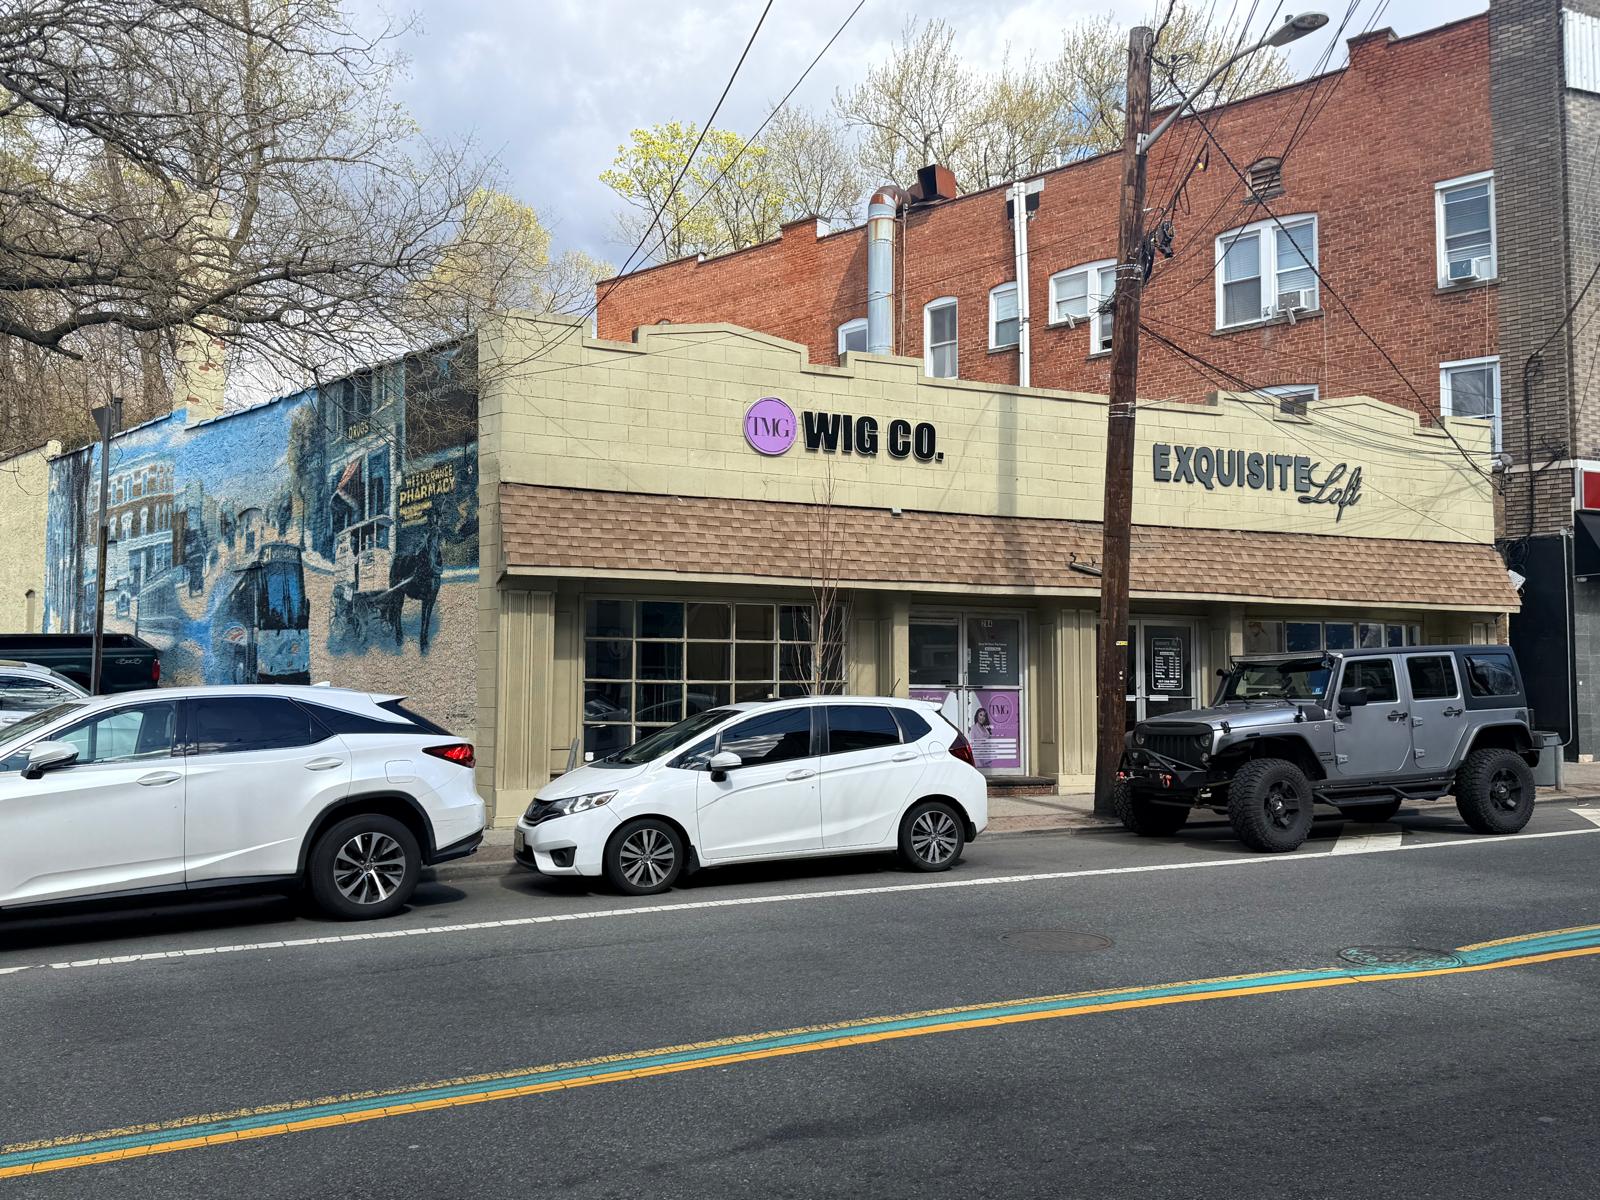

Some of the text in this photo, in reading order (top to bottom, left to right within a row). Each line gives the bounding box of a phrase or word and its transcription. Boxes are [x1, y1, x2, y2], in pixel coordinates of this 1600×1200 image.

[748, 416, 791, 438] TMG
[803, 411, 879, 456] WIG
[888, 419, 944, 463] CO.
[399, 477, 455, 506] PHARMACY
[1152, 442, 1363, 524] EXQUISITE Loft
